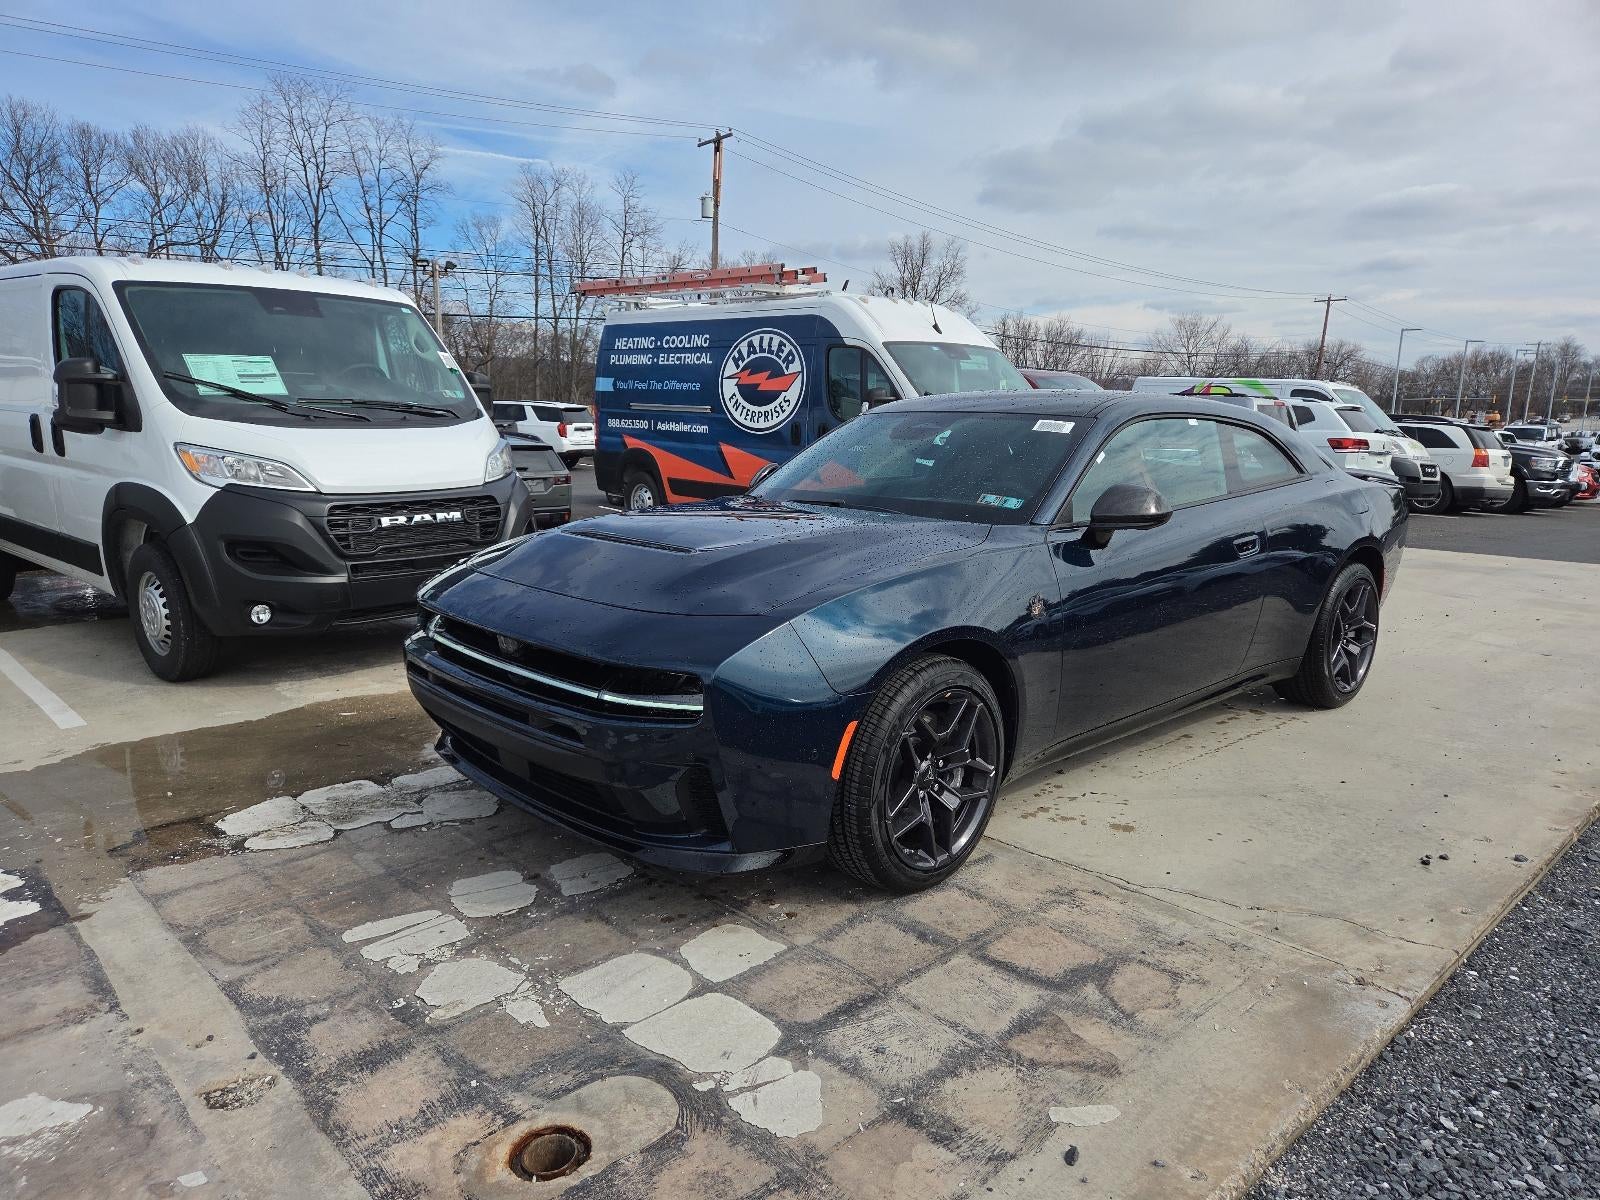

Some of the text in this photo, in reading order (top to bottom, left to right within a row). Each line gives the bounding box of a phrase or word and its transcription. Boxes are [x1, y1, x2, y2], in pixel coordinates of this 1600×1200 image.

[614, 334, 711, 350] HEATING COOLING
[609, 352, 713, 365] PLUMBING ELECTRICAL
[731, 335, 796, 372] HALLER
[616, 380, 701, 391] You'll Feel The Difference
[728, 392, 791, 423] ENTERPRISES
[607, 418, 710, 434] 888.625.1500 AskHaller.com
[380, 512, 462, 527] RAM
